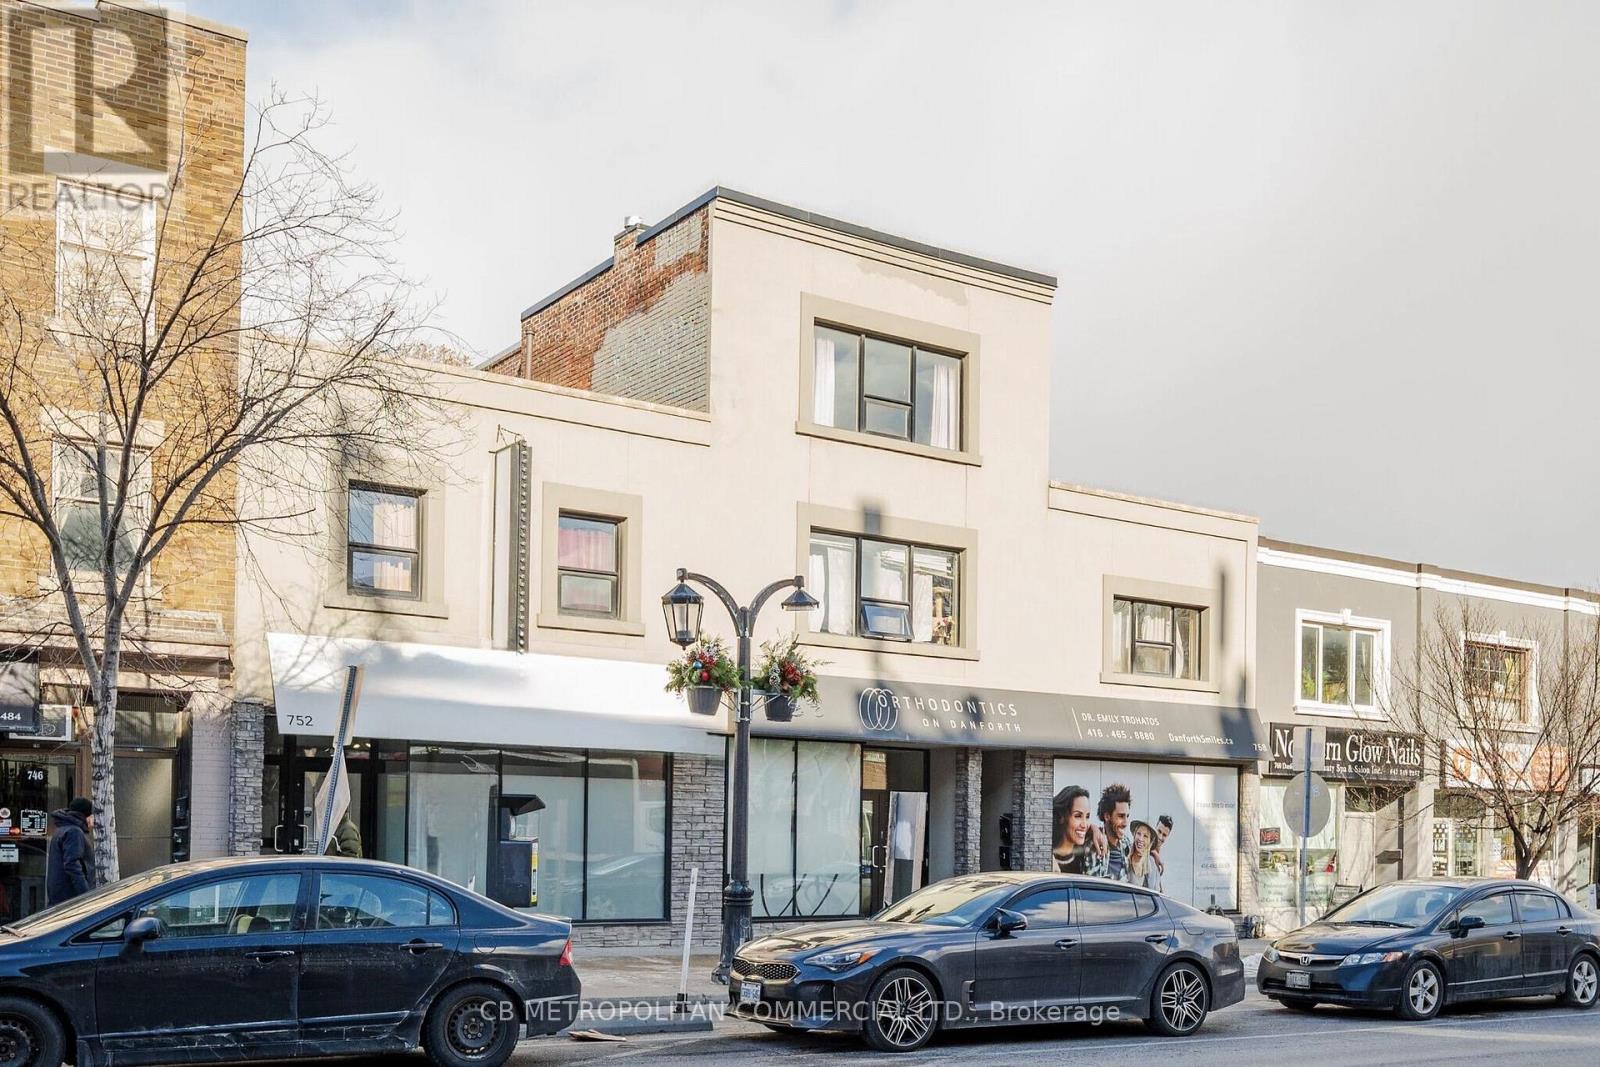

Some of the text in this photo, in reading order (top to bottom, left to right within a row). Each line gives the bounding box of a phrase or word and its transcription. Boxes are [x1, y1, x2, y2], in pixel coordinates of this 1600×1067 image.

[878, 694, 1018, 717] ORTHODONTICS
[286, 714, 314, 726] 752
[1081, 712, 1096, 722] DR.
[1096, 713, 1119, 723] EMILY
[922, 718, 1022, 732] ON DANFORTH
[1346, 735, 1383, 763] Glow
[1386, 737, 1421, 766] Nails
[27, 769, 44, 781] 746
